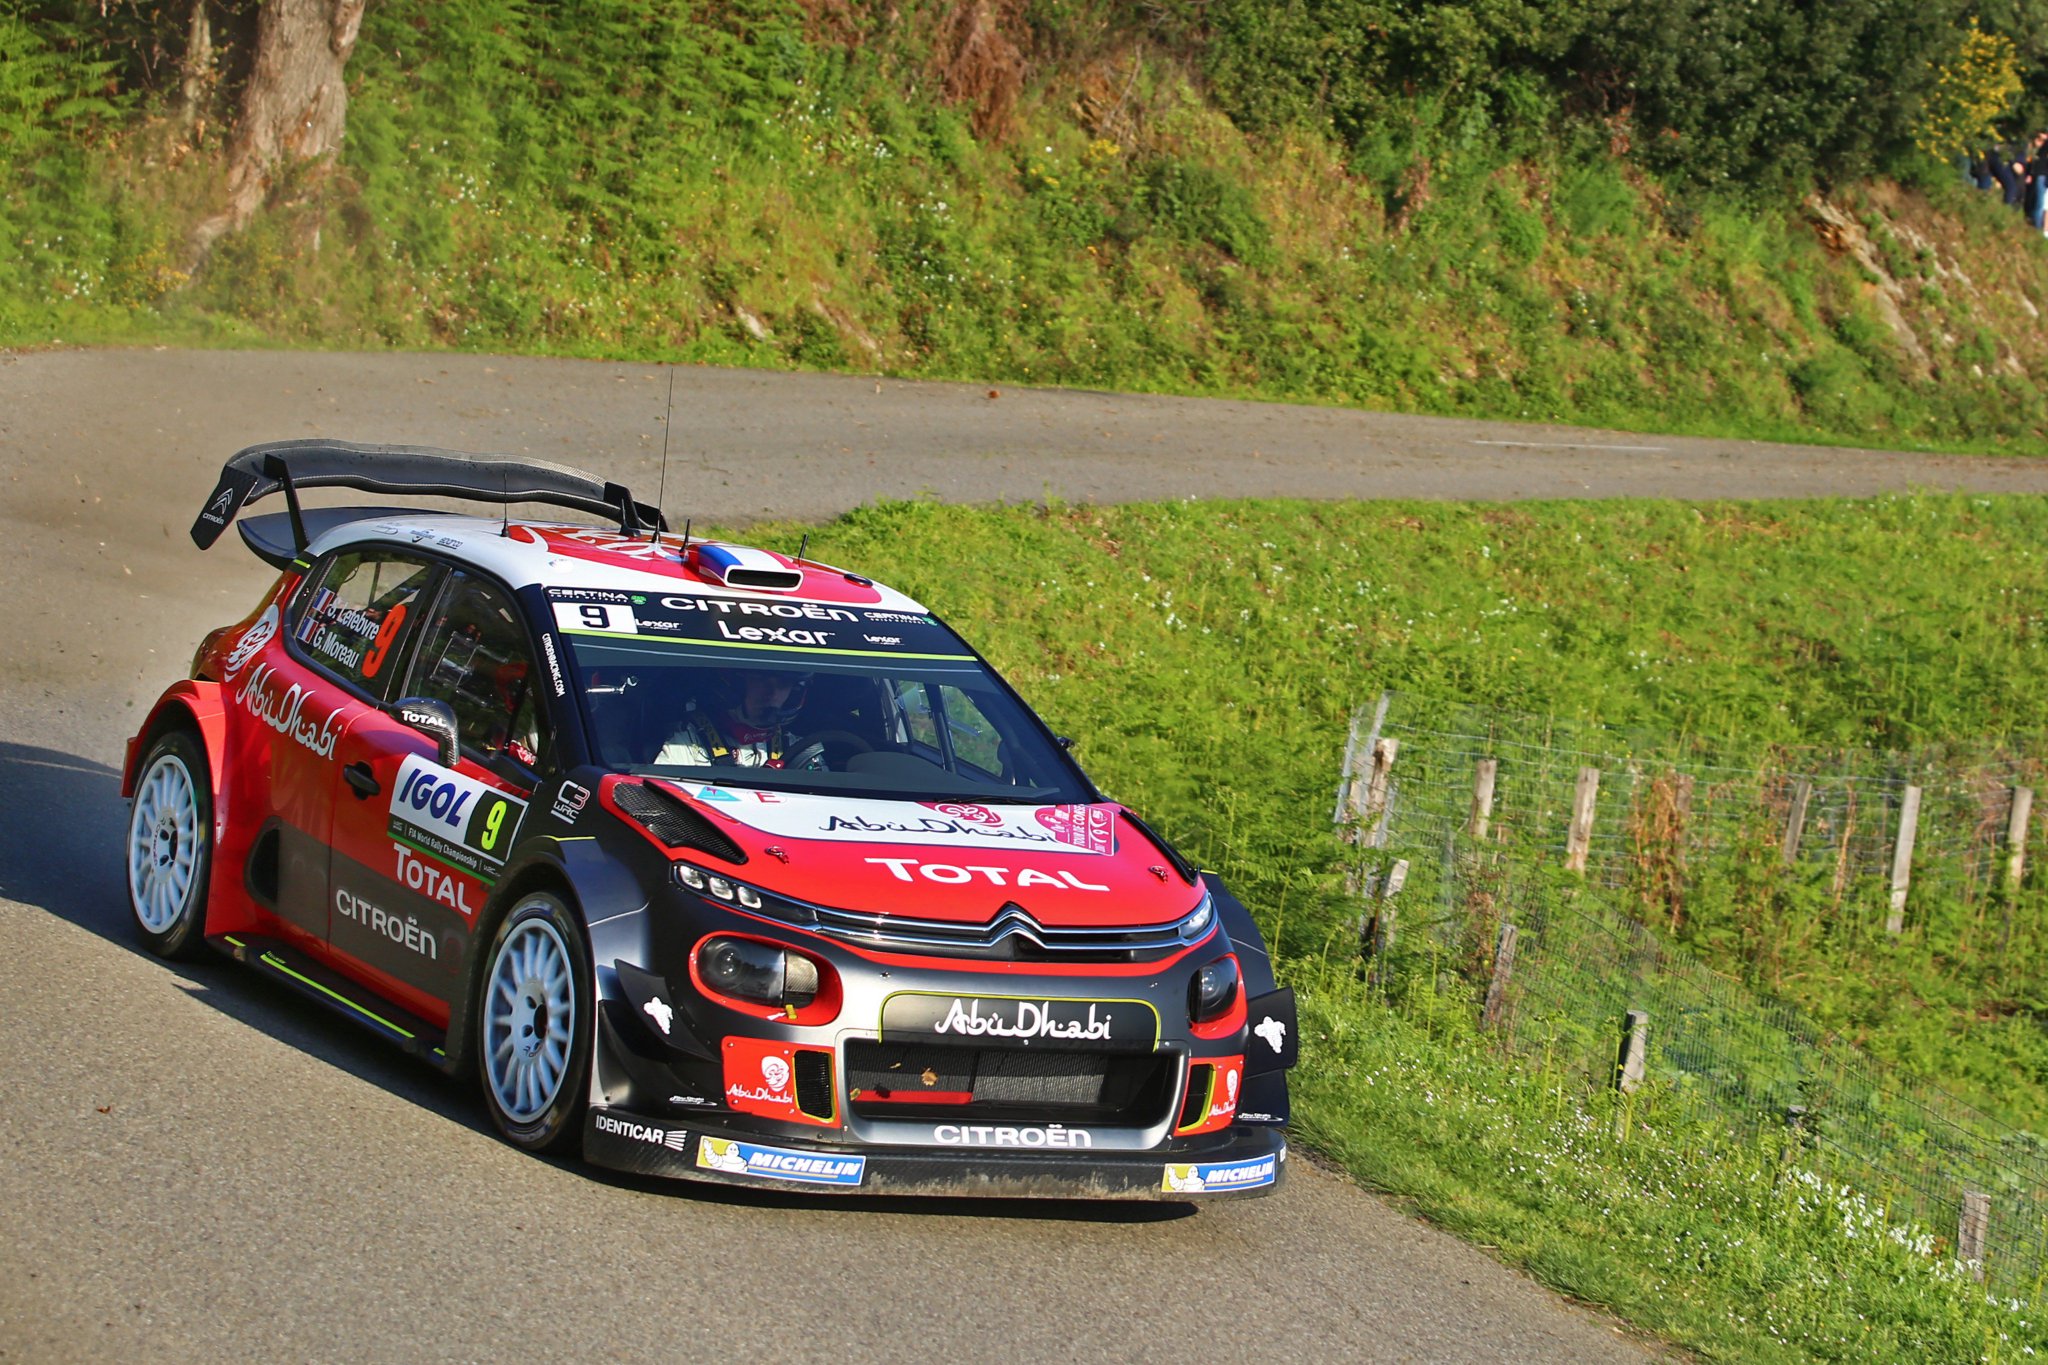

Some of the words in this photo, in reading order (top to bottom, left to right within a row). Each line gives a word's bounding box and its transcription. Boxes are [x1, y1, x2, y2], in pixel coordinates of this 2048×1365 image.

[549, 588, 629, 600] CERTINA
[337, 602, 380, 641] Lefebvre
[580, 604, 611, 629] 9
[635, 618, 679, 629] Lexar
[361, 603, 407, 678] 9
[718, 620, 829, 646] Lexar
[321, 631, 360, 669] Moreau
[401, 710, 448, 728] TOTAL
[399, 768, 472, 828] IGOL
[481, 800, 507, 851] 9
[443, 844, 477, 869] Championship
[394, 842, 472, 915] TOTAL
[864, 857, 1111, 892] TOTAL
[596, 1114, 665, 1145] IDENTICAR
[748, 1151, 862, 1176] MICHELIN
[1205, 1160, 1275, 1183] MICHELIN
